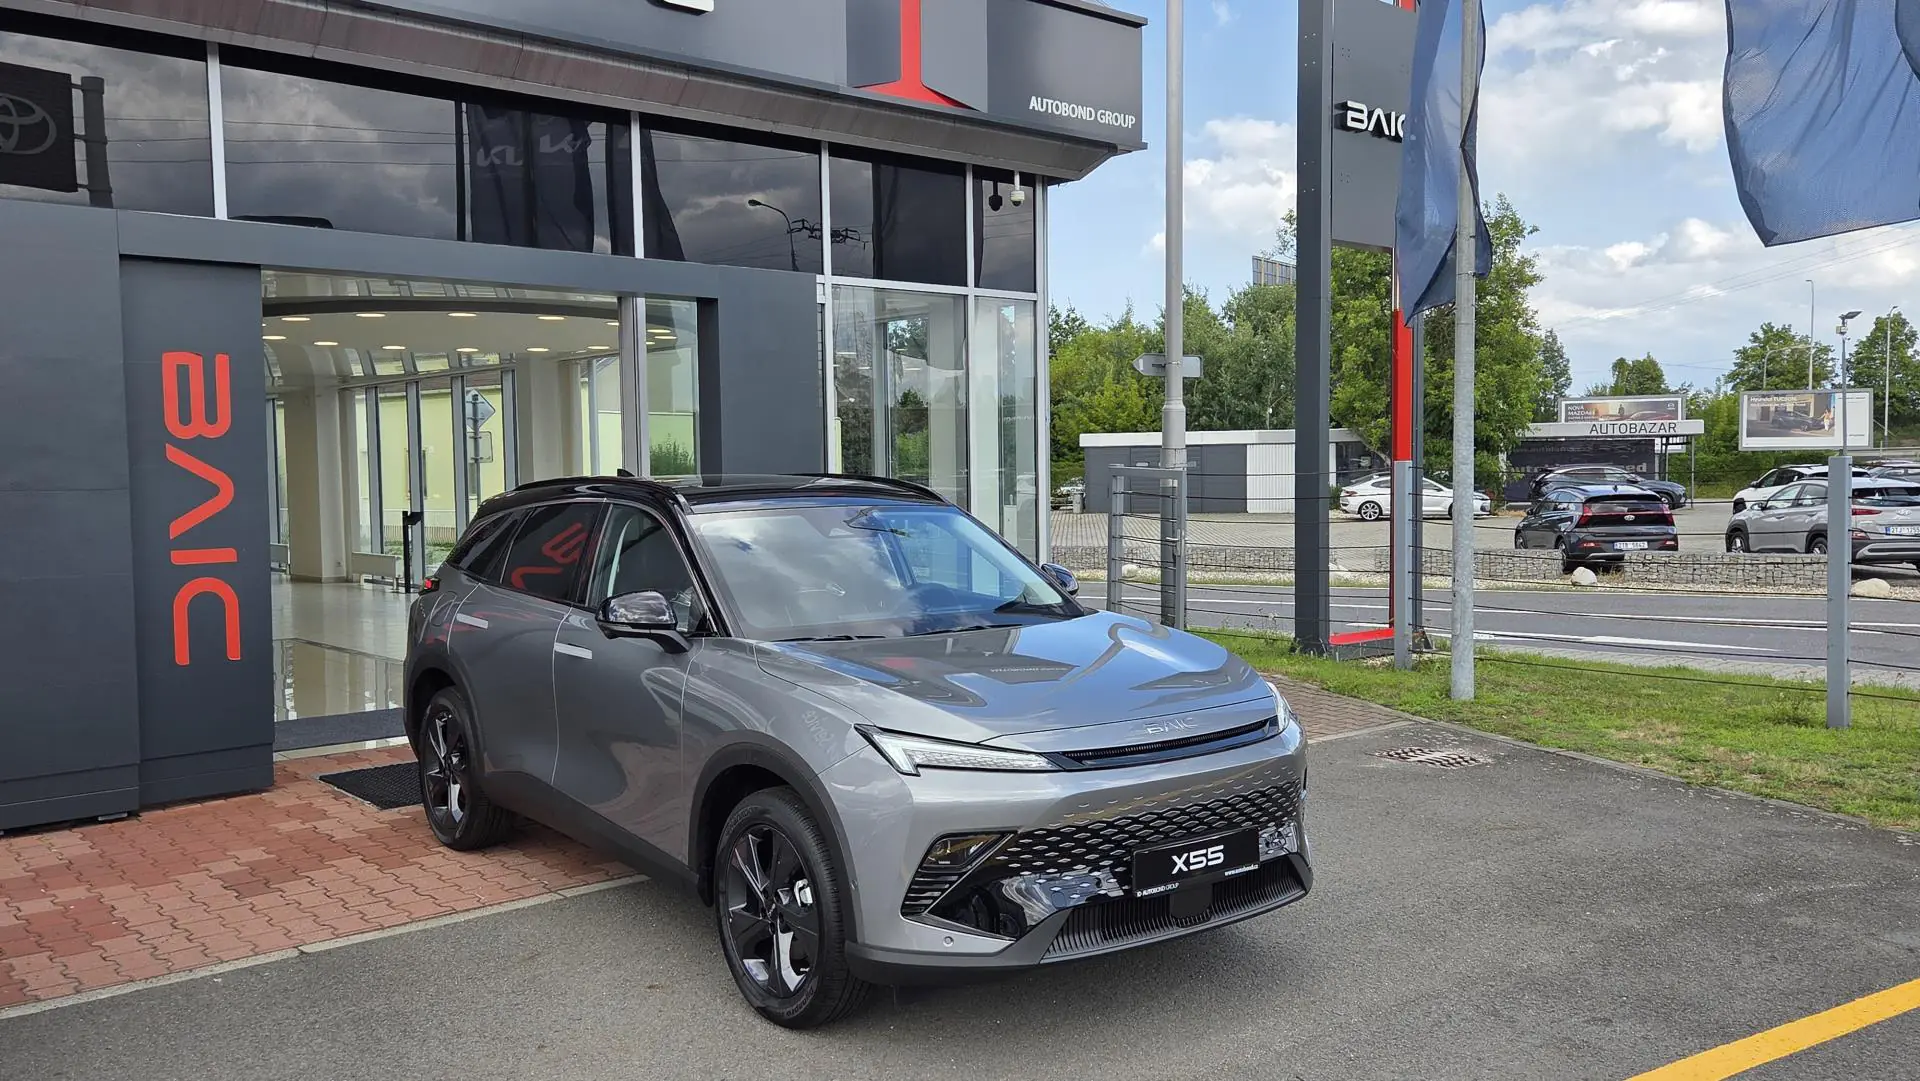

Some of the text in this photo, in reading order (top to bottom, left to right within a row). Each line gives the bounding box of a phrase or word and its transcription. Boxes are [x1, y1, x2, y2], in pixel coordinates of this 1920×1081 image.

[1029, 96, 1136, 129] AUTOBOND GROUP
[1589, 422, 1678, 435] AUTOBAZAR
[162, 351, 241, 666] BAIC
[1144, 717, 1199, 735] BAIC
[1171, 844, 1225, 875] X55
